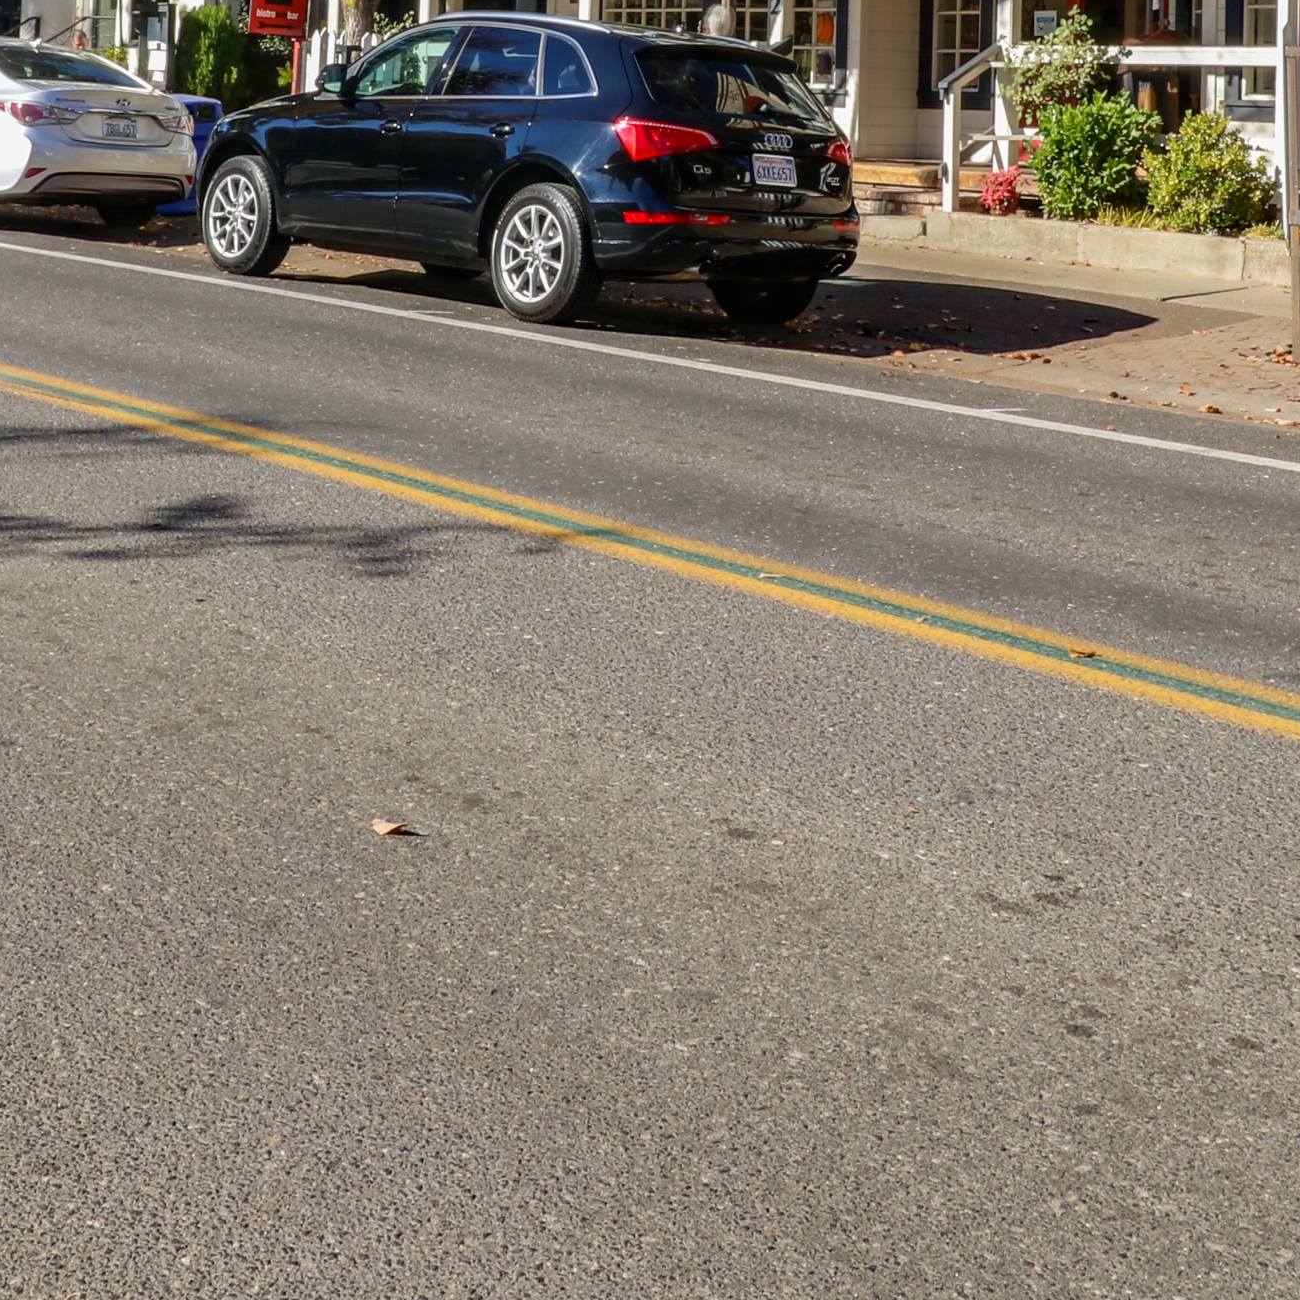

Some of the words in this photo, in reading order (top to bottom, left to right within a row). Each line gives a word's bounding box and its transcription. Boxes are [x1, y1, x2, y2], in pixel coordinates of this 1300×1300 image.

[256, 8, 276, 18] bistro
[286, 11, 299, 20] bar
[693, 164, 712, 175] Q5
[757, 166, 792, 182] 6XKE657
